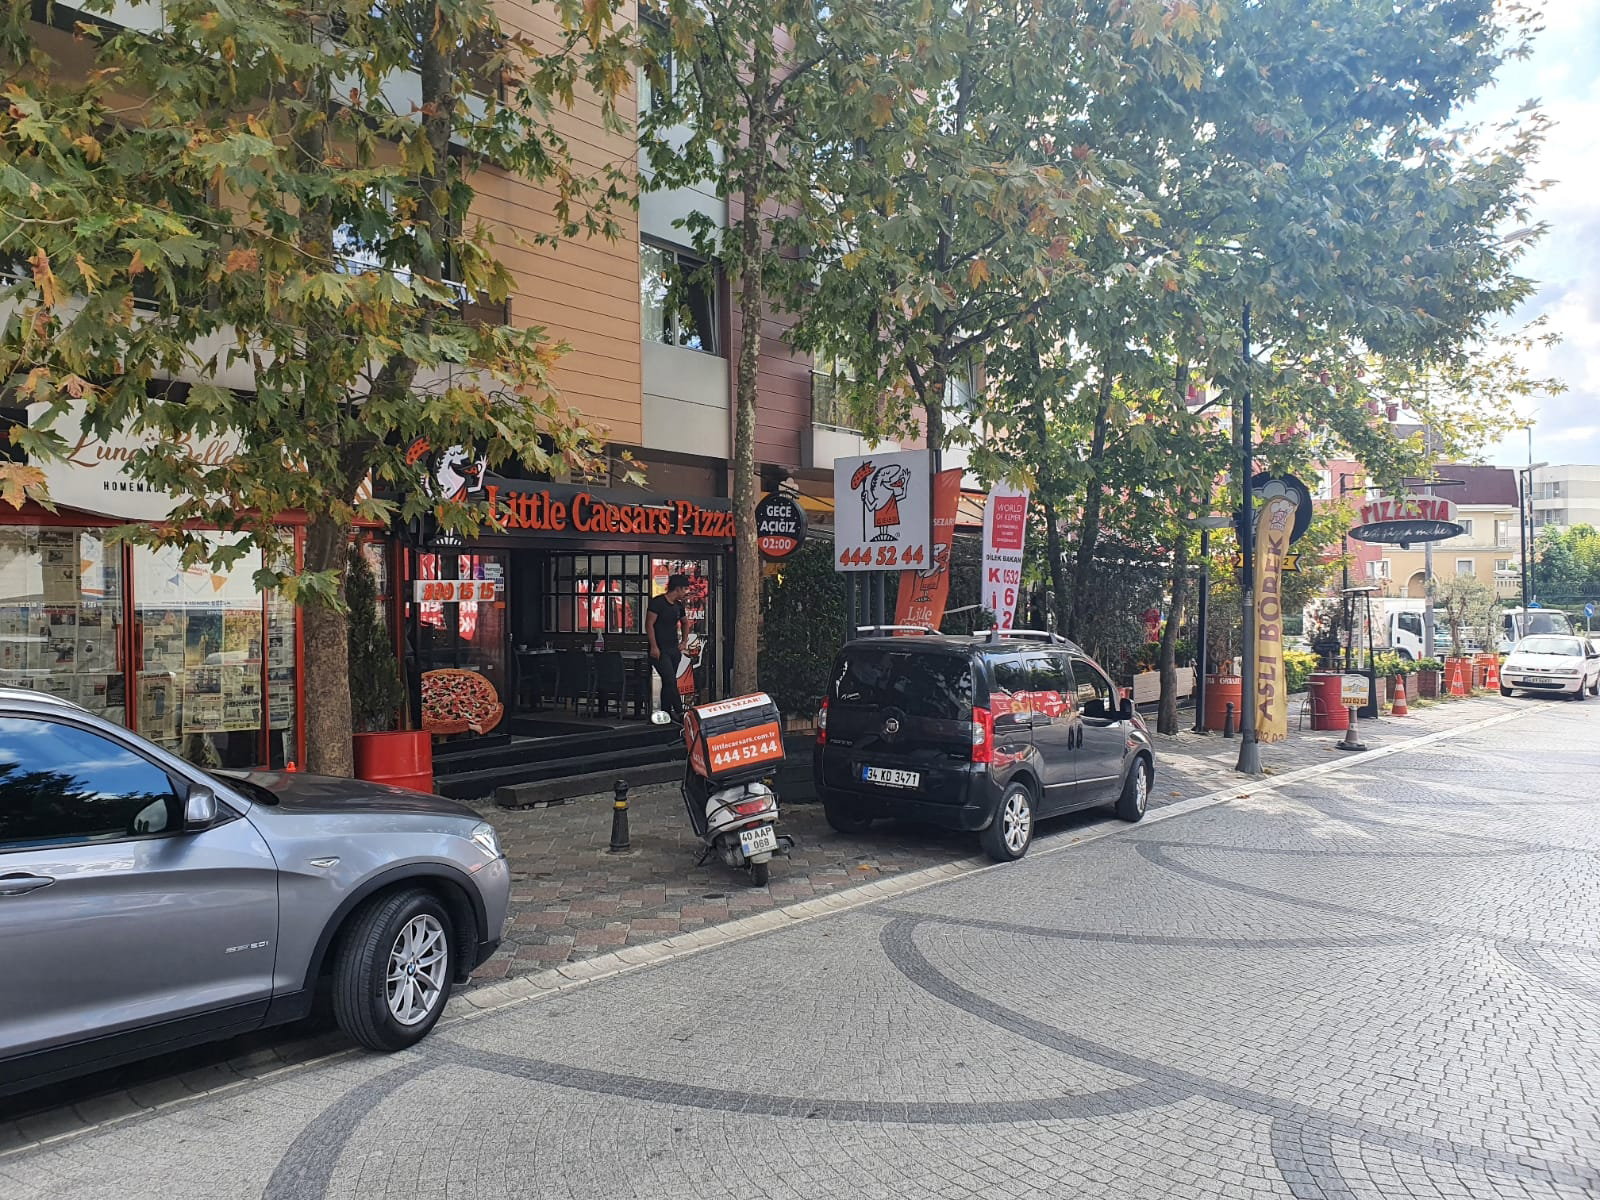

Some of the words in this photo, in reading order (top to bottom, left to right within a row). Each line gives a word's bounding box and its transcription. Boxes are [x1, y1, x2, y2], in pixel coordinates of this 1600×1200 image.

[485, 483, 567, 531] Little
[572, 491, 671, 535] Caesars
[675, 500, 736, 537] Pizza
[766, 505, 792, 517] GECE
[997, 503, 1022, 512] WORLD
[759, 518, 796, 535] AÇIĞIZ
[762, 538, 791, 550] 02:00
[840, 546, 873, 566] 444
[876, 545, 898, 565] 52
[901, 544, 924, 565] 44
[1257, 534, 1283, 643] BÖREK
[1258, 656, 1277, 722] ASLI
[714, 749, 740, 765] 444
[742, 744, 759, 759] 52
[760, 740, 778, 754] 44
[867, 768, 877, 779] 34
[894, 772, 917, 784] 3471
[742, 831, 753, 842] 40
[754, 826, 771, 839] AAP
